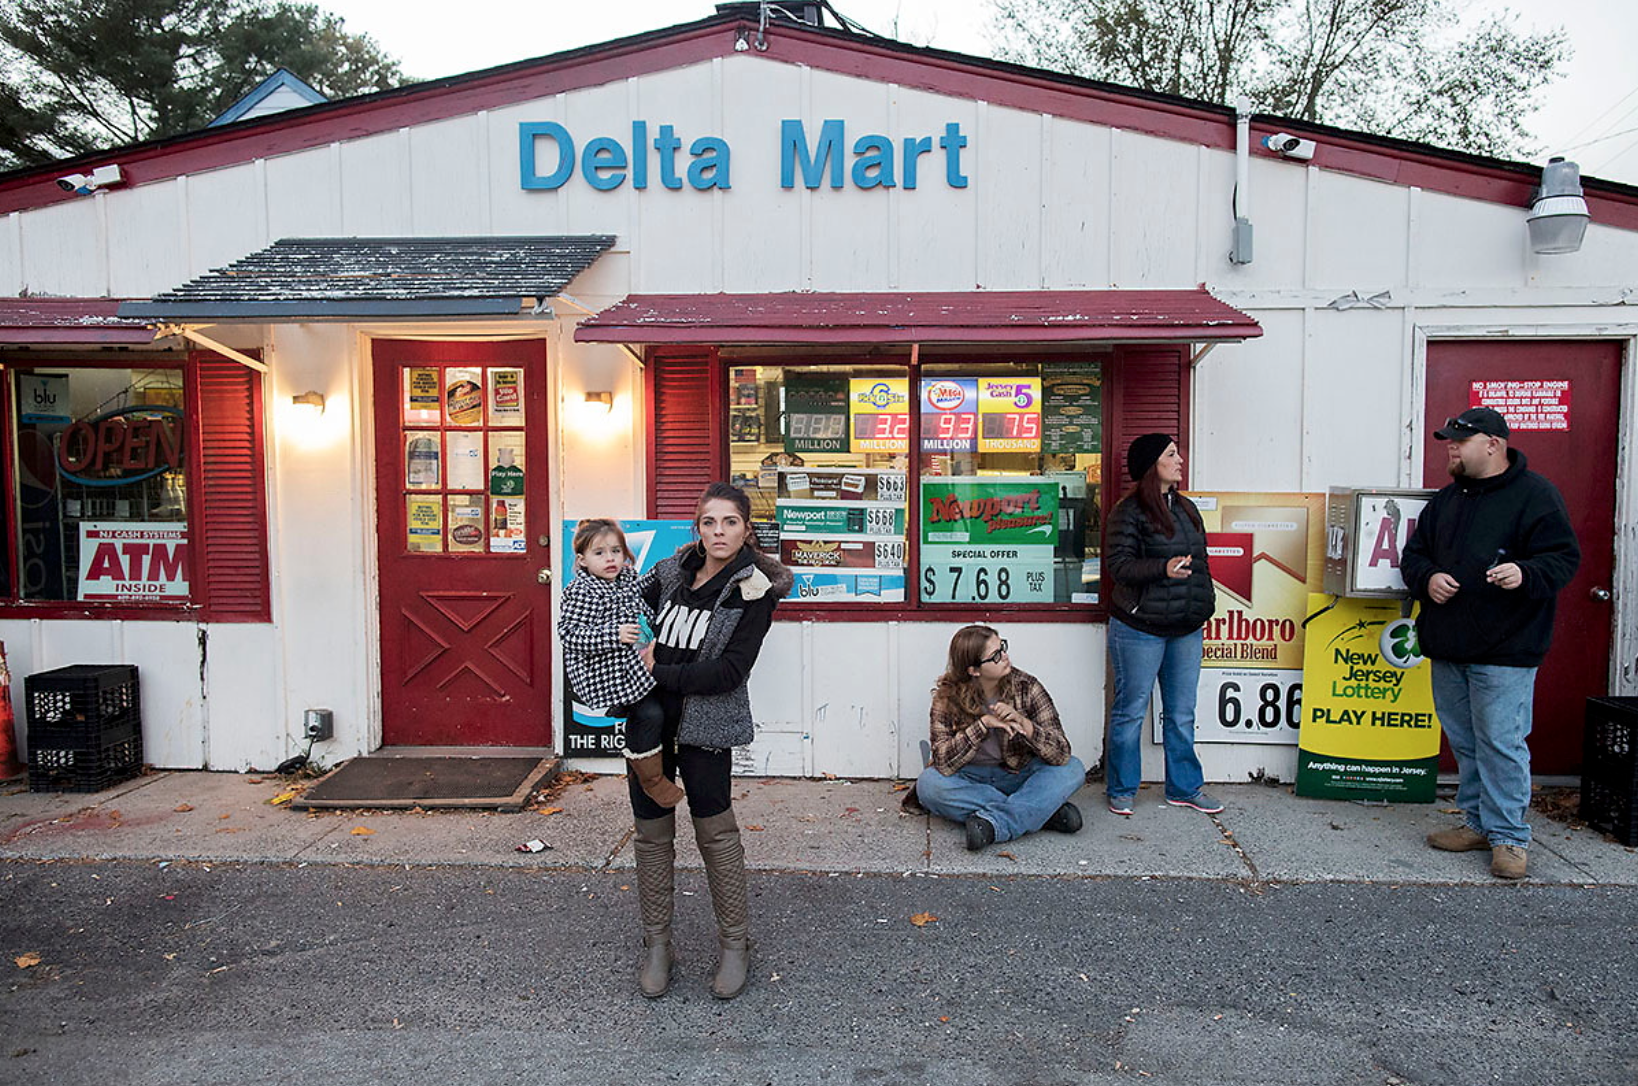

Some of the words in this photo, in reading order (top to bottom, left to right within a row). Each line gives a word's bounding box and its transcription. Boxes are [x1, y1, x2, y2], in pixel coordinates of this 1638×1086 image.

[519, 120, 732, 192] Delta
[781, 119, 968, 190] Mart
[990, 390, 1012, 398] Cash
[1472, 382, 1484, 390] NO
[34, 388, 56, 405] blu
[1014, 384, 1033, 408] 5
[939, 414, 975, 438] 93
[1006, 414, 1038, 437] 75
[59, 419, 184, 472] OPEN
[795, 440, 840, 449] MILLION
[860, 440, 906, 449] MILLION
[924, 440, 970, 449] MILLION
[985, 440, 1038, 449] THOUSAND
[928, 489, 1041, 523] Newport
[783, 509, 824, 520] Newport
[868, 510, 894, 526] $668
[986, 511, 1053, 534] pleasure!
[99, 531, 114, 539] NJ
[114, 531, 141, 539] CASH
[143, 531, 182, 539] SYSTEMS
[794, 552, 842, 560] MAVERICK
[876, 544, 902, 560] $640
[952, 550, 988, 558] SPECIAL
[990, 550, 1018, 558] OFFER
[85, 543, 189, 582] ATM
[1026, 572, 1046, 582] PLUS
[115, 584, 167, 593] INSIDE
[799, 584, 820, 598] blu
[1029, 582, 1043, 592] TAX
[1202, 610, 1296, 642] arlboro
[1201, 643, 1238, 660] pecial
[1240, 643, 1278, 660] Blend
[1334, 648, 1380, 666] New
[1342, 666, 1405, 687] Jersey
[1332, 681, 1403, 704] Lottery
[1218, 682, 1302, 730] 6.86
[1312, 708, 1366, 726] PLAY
[1371, 711, 1433, 729] HERE!
[568, 734, 596, 749] THE
[600, 735, 626, 749] RIG
[1308, 761, 1346, 772] Anything
[1362, 764, 1391, 774] happen
